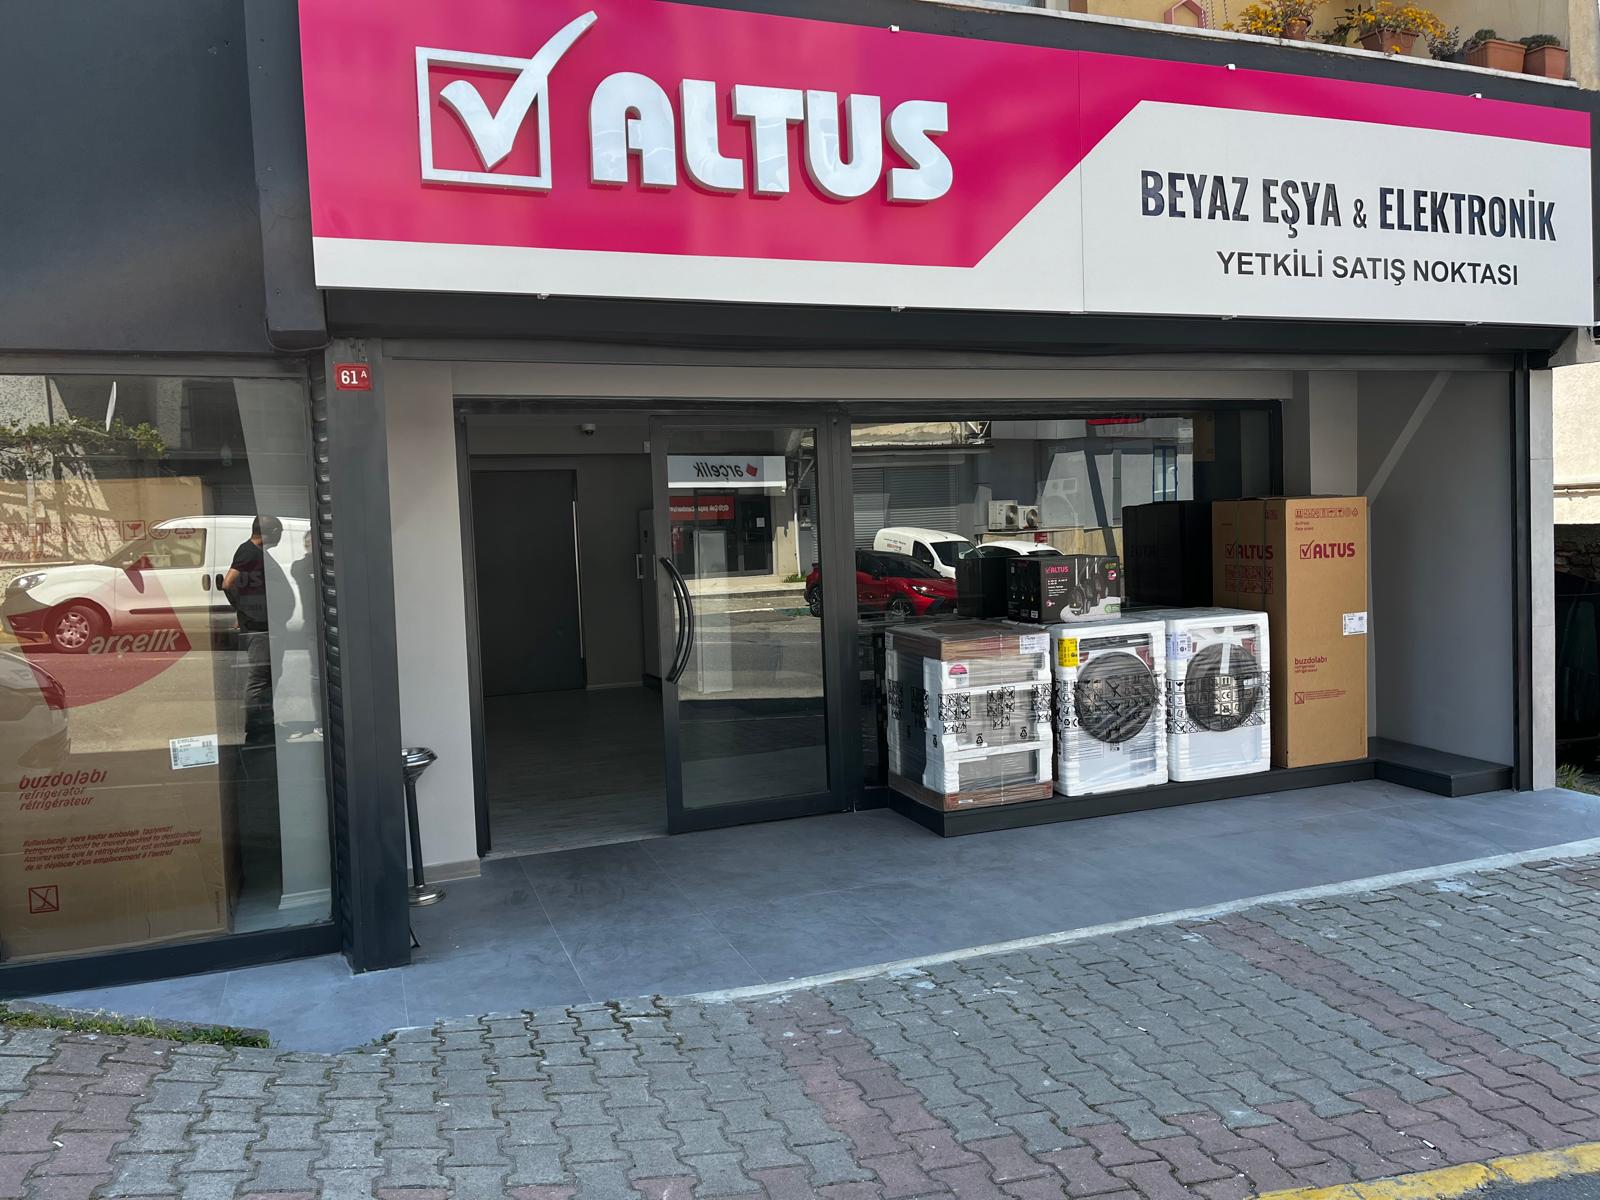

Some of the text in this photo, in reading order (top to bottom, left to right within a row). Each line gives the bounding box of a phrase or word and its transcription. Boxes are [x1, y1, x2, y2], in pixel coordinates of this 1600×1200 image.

[589, 72, 954, 202] ALTUS
[1141, 170, 1557, 241] BEYAZ EŞYA & ELEKTRONİK
[1217, 249, 1518, 286] YETKİLİ SATIŞ NOKTASI
[341, 370, 367, 384] 61 A
[1236, 544, 1273, 559] ALTUS
[1313, 542, 1355, 559] ALTUS
[1050, 566, 1069, 574] ALTUS
[19, 786, 87, 800] refrigerator
